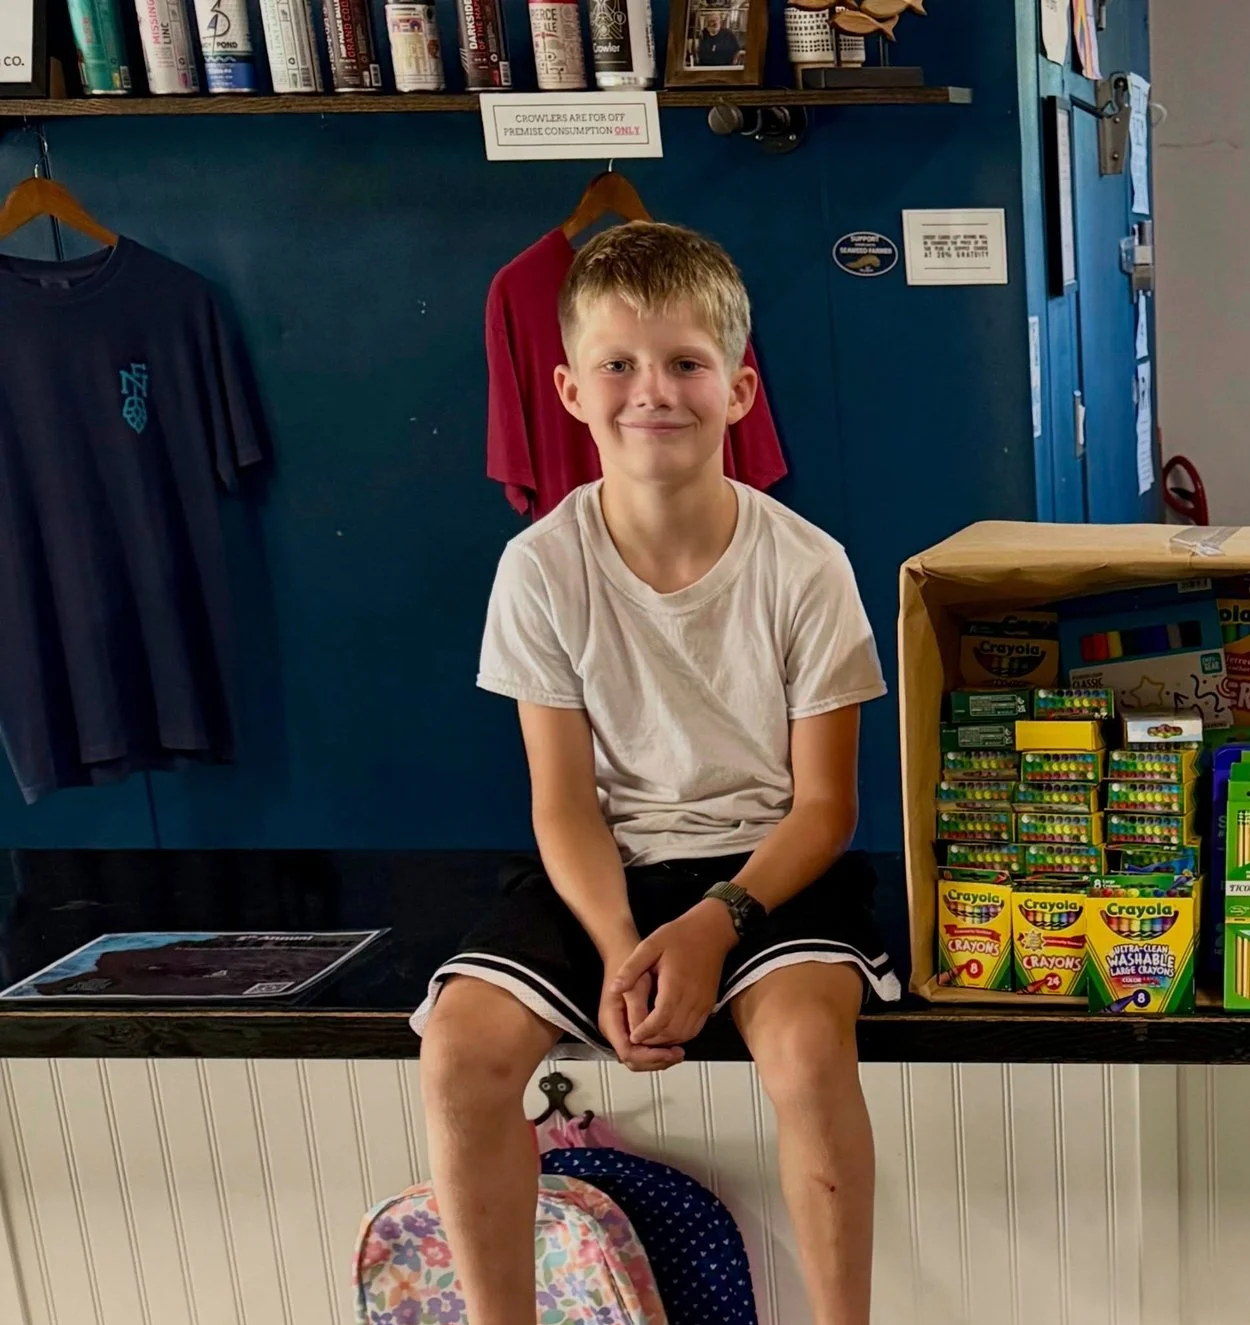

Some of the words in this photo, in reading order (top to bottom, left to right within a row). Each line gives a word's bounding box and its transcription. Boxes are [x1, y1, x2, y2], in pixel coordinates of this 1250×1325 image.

[3, 55, 25, 66] CO.
[515, 113, 568, 124] CROWLERS
[569, 113, 587, 123] ARE
[588, 113, 607, 122] FOR
[607, 113, 626, 122] OFF
[503, 127, 543, 137] PREMISE
[544, 127, 613, 136] CONSUMPTION
[614, 126, 640, 136] ONLY
[979, 640, 1041, 657] Crayola
[1093, 878, 1101, 889] 8
[947, 889, 1000, 904] Crayola
[1024, 899, 1078, 912] Crayola
[1106, 903, 1175, 918] Crayola
[947, 938, 1000, 957] CRAYONS
[1113, 944, 1169, 955] ULTRA-CLEAN
[1022, 954, 1083, 972] CRAYONS
[1108, 952, 1176, 969] WASHABLE
[970, 963, 978, 973] 8
[1110, 966, 1137, 977] LARGE
[1138, 966, 1175, 978] CRAYONS
[1046, 976, 1061, 986] 24
[1137, 992, 1146, 1003] 8
